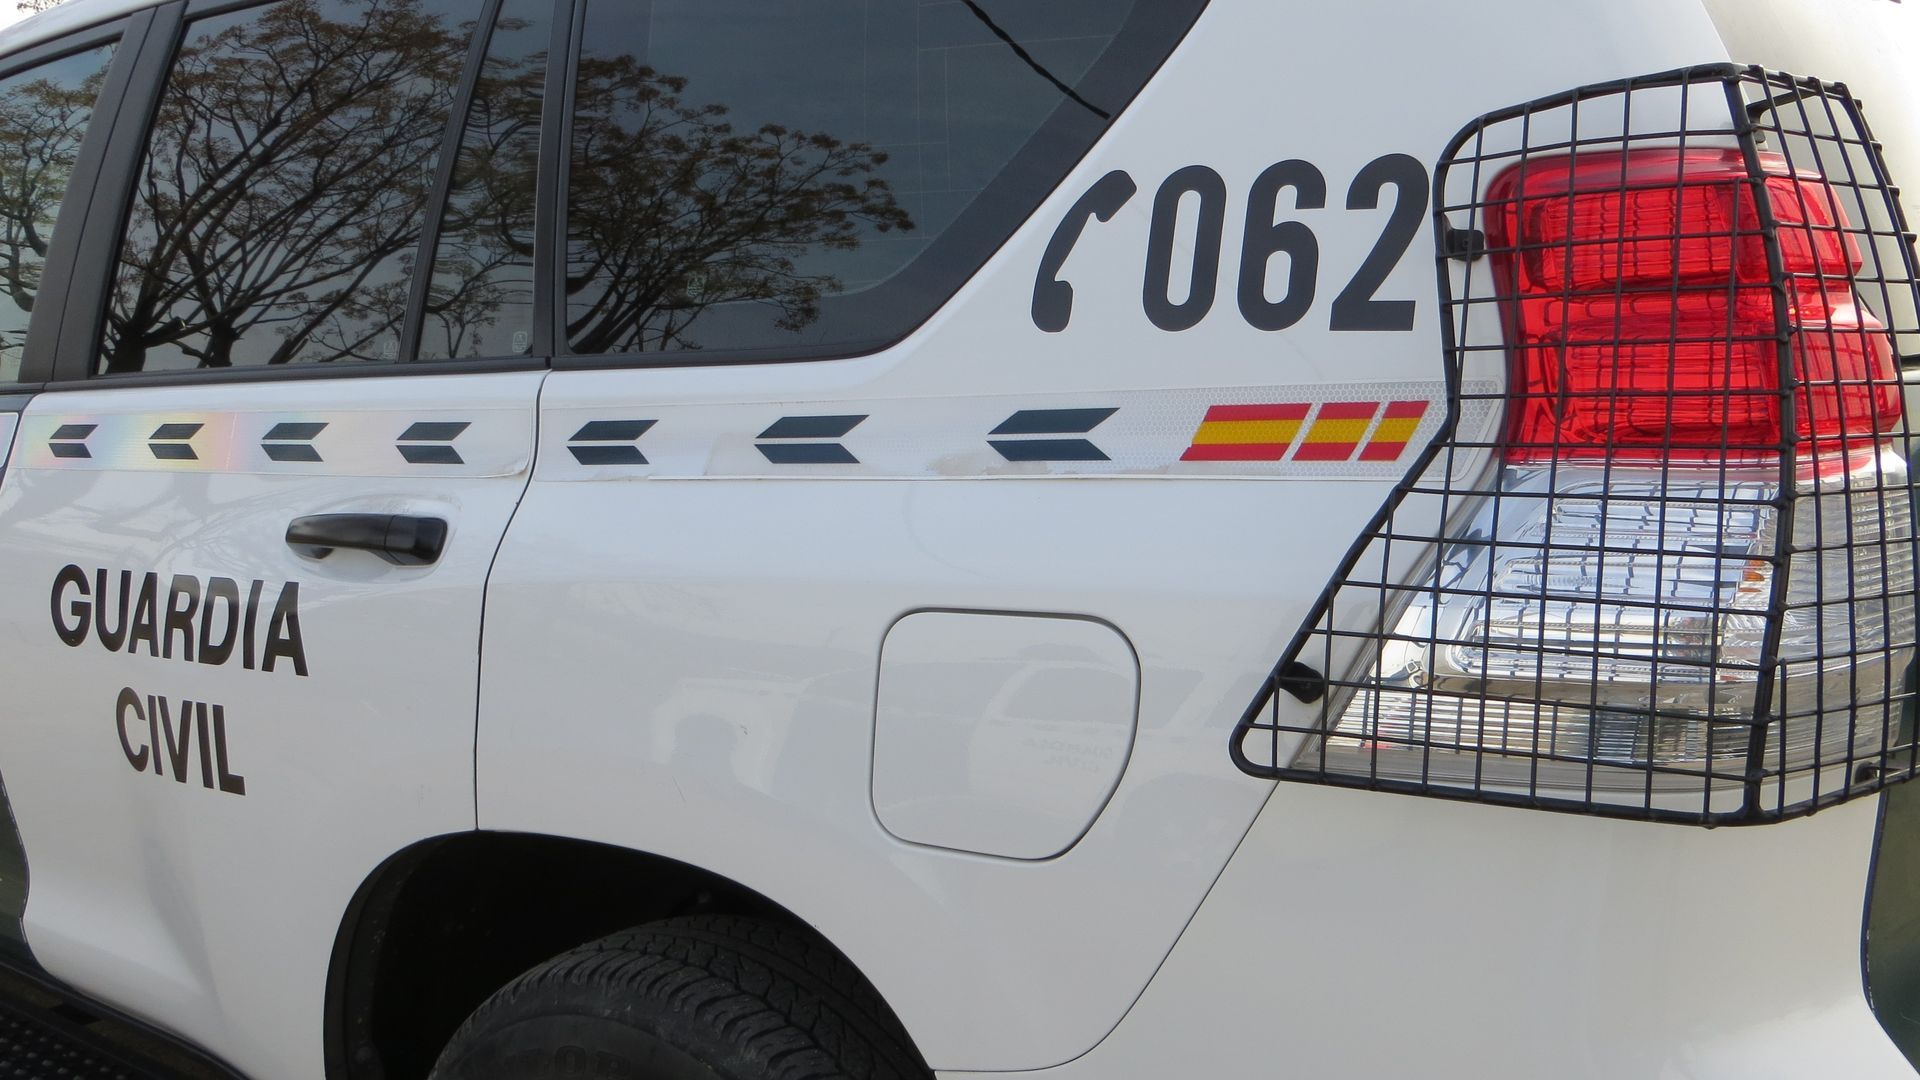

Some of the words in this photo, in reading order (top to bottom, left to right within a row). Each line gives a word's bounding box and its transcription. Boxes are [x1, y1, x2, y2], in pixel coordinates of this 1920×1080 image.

[1143, 153, 1429, 331] 062
[51, 564, 309, 676] GUARDIA
[116, 687, 246, 795] CIVIL
